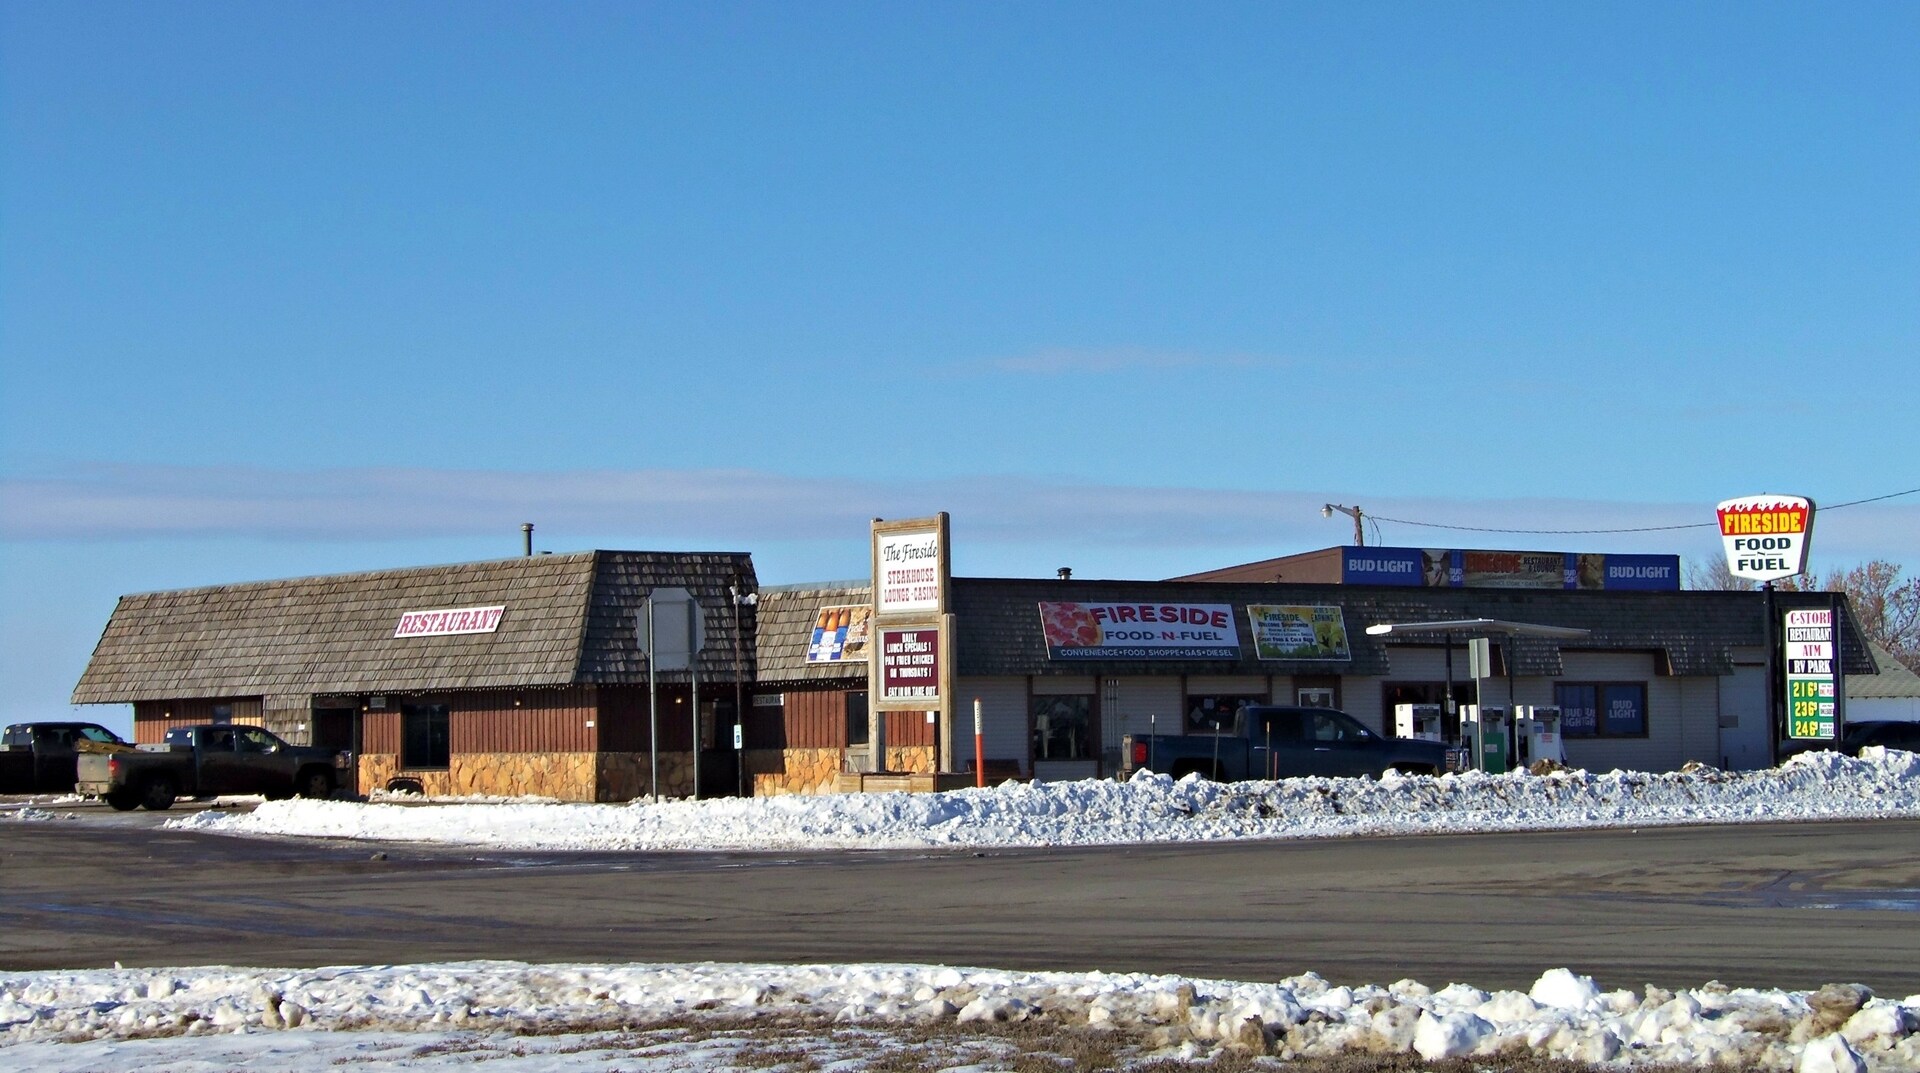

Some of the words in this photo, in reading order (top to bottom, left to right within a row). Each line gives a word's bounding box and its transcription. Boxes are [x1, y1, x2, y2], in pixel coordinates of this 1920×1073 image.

[1724, 512, 1801, 534] FIRESIDE
[1735, 537, 1791, 550] FOOD
[884, 543, 901, 562] The
[902, 540, 937, 563] Fireside
[1348, 559, 1375, 572] BUD
[1377, 560, 1413, 573] LIGHT
[1523, 556, 1561, 565] RESTAURANT
[1738, 558, 1790, 571] FUEL
[1533, 565, 1556, 573] LOUNGE
[1609, 566, 1636, 578] BUD
[1636, 567, 1671, 579] LIGHT
[887, 568, 934, 585] STEAKHOUSE
[884, 587, 910, 603] LOUNGE
[914, 586, 937, 601] CASINO
[397, 609, 502, 635] RESTAURANT
[1089, 604, 1228, 629] FIRESIDE
[1263, 612, 1300, 621] FIRESIDE
[1802, 645, 1822, 656] ATM
[1793, 660, 1806, 673] RV
[1807, 660, 1831, 673] PARK
[1612, 700, 1633, 709] BUD
[1564, 708, 1582, 718] BUD
[1608, 709, 1637, 719] LIGHT
